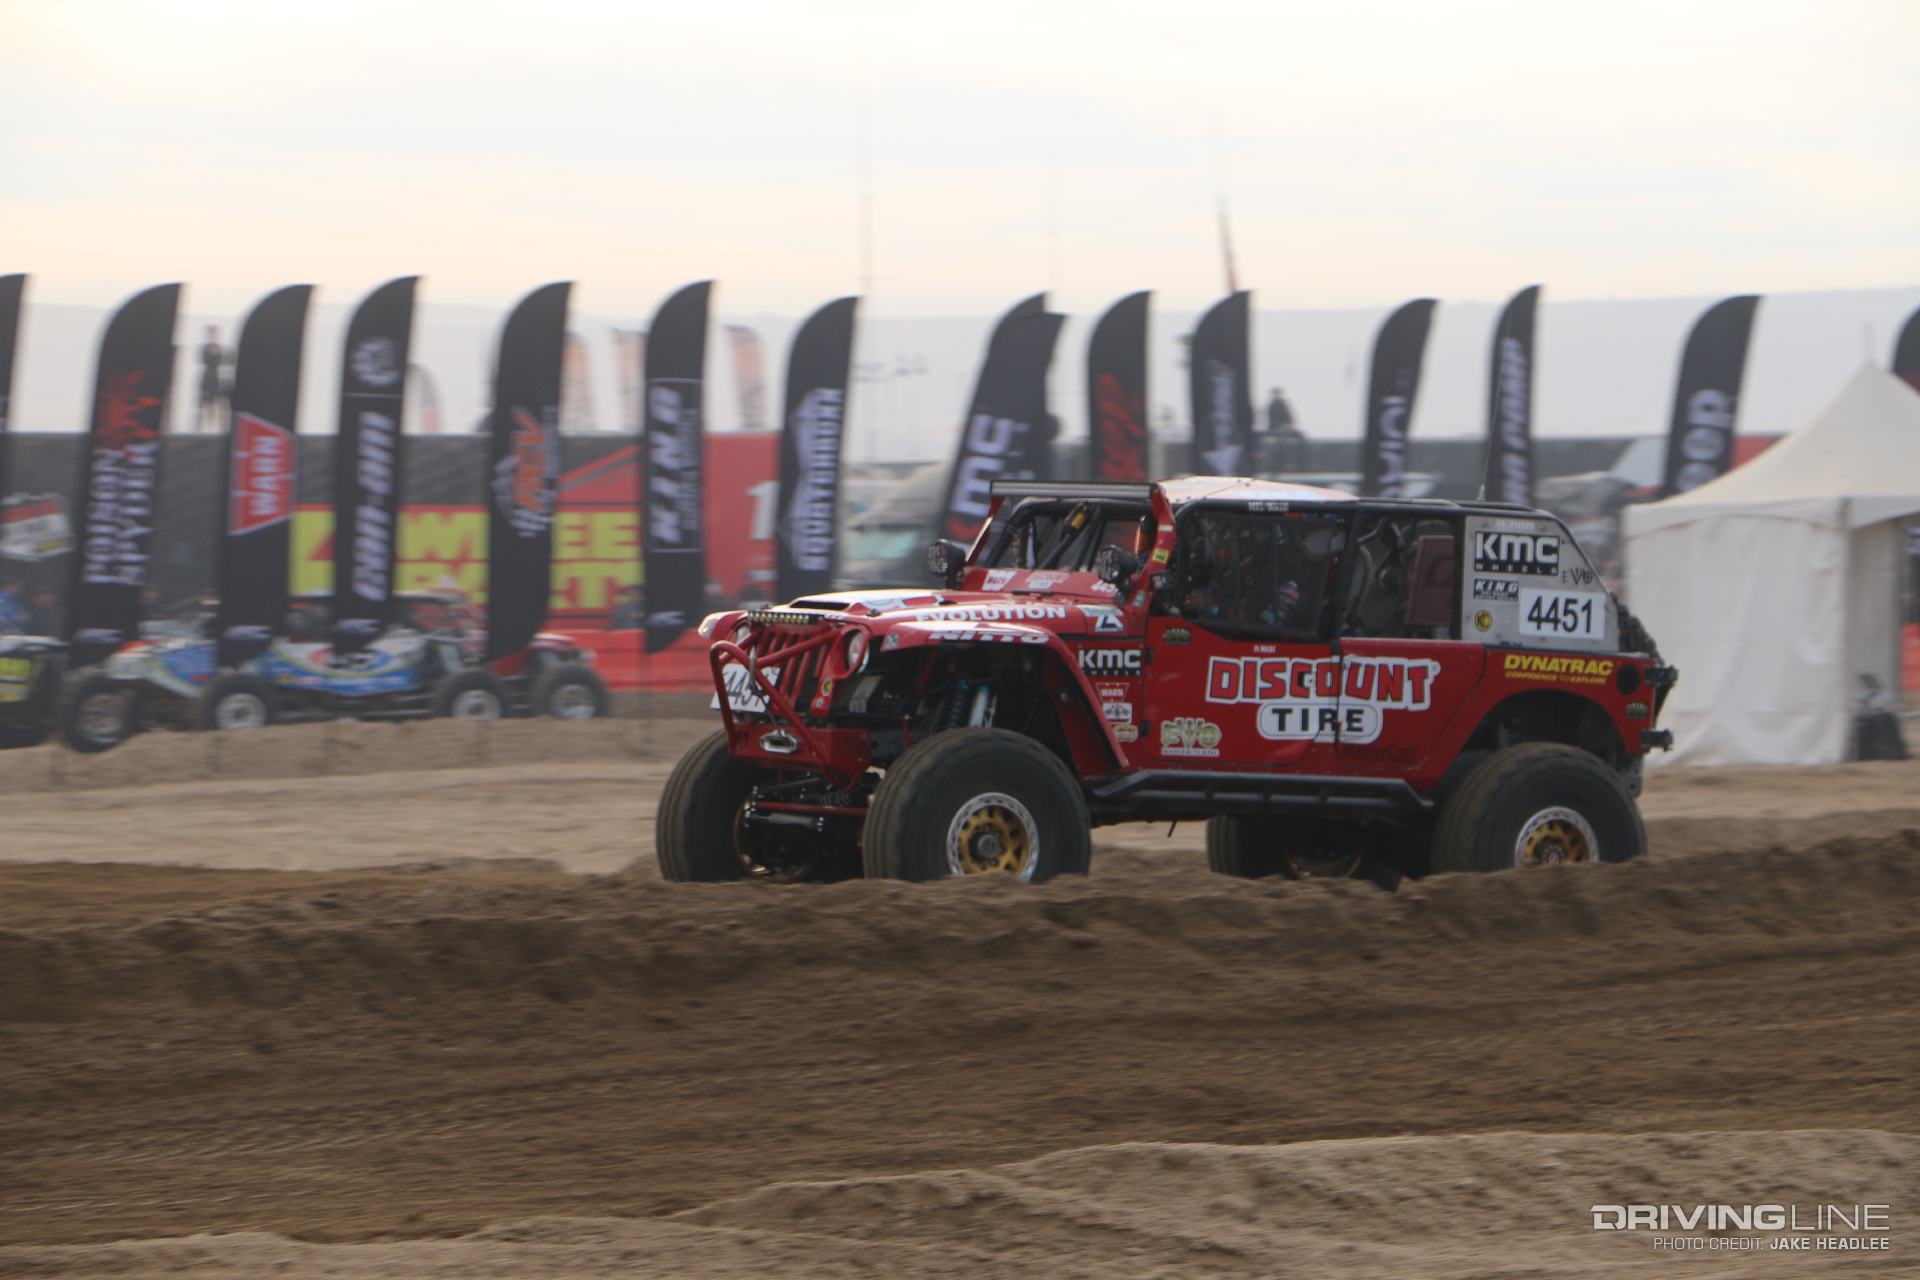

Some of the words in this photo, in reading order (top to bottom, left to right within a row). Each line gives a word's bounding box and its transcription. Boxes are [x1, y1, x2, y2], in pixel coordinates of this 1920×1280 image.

[249, 436, 282, 517] WARN
[1475, 533, 1559, 563] KMC
[1475, 563, 1558, 575] WHEELS
[1475, 579, 1519, 594] KING
[916, 606, 1067, 623] EVOLUTION
[1527, 595, 1593, 634] 4451
[1078, 649, 1142, 669] KMC
[1504, 654, 1614, 676] DYNATRAC
[1208, 657, 1431, 709] DISCOUNT
[1505, 671, 1557, 682] CONFIDENCE
[1570, 675, 1607, 685] EXPLORE
[1271, 707, 1365, 733] TIRE
